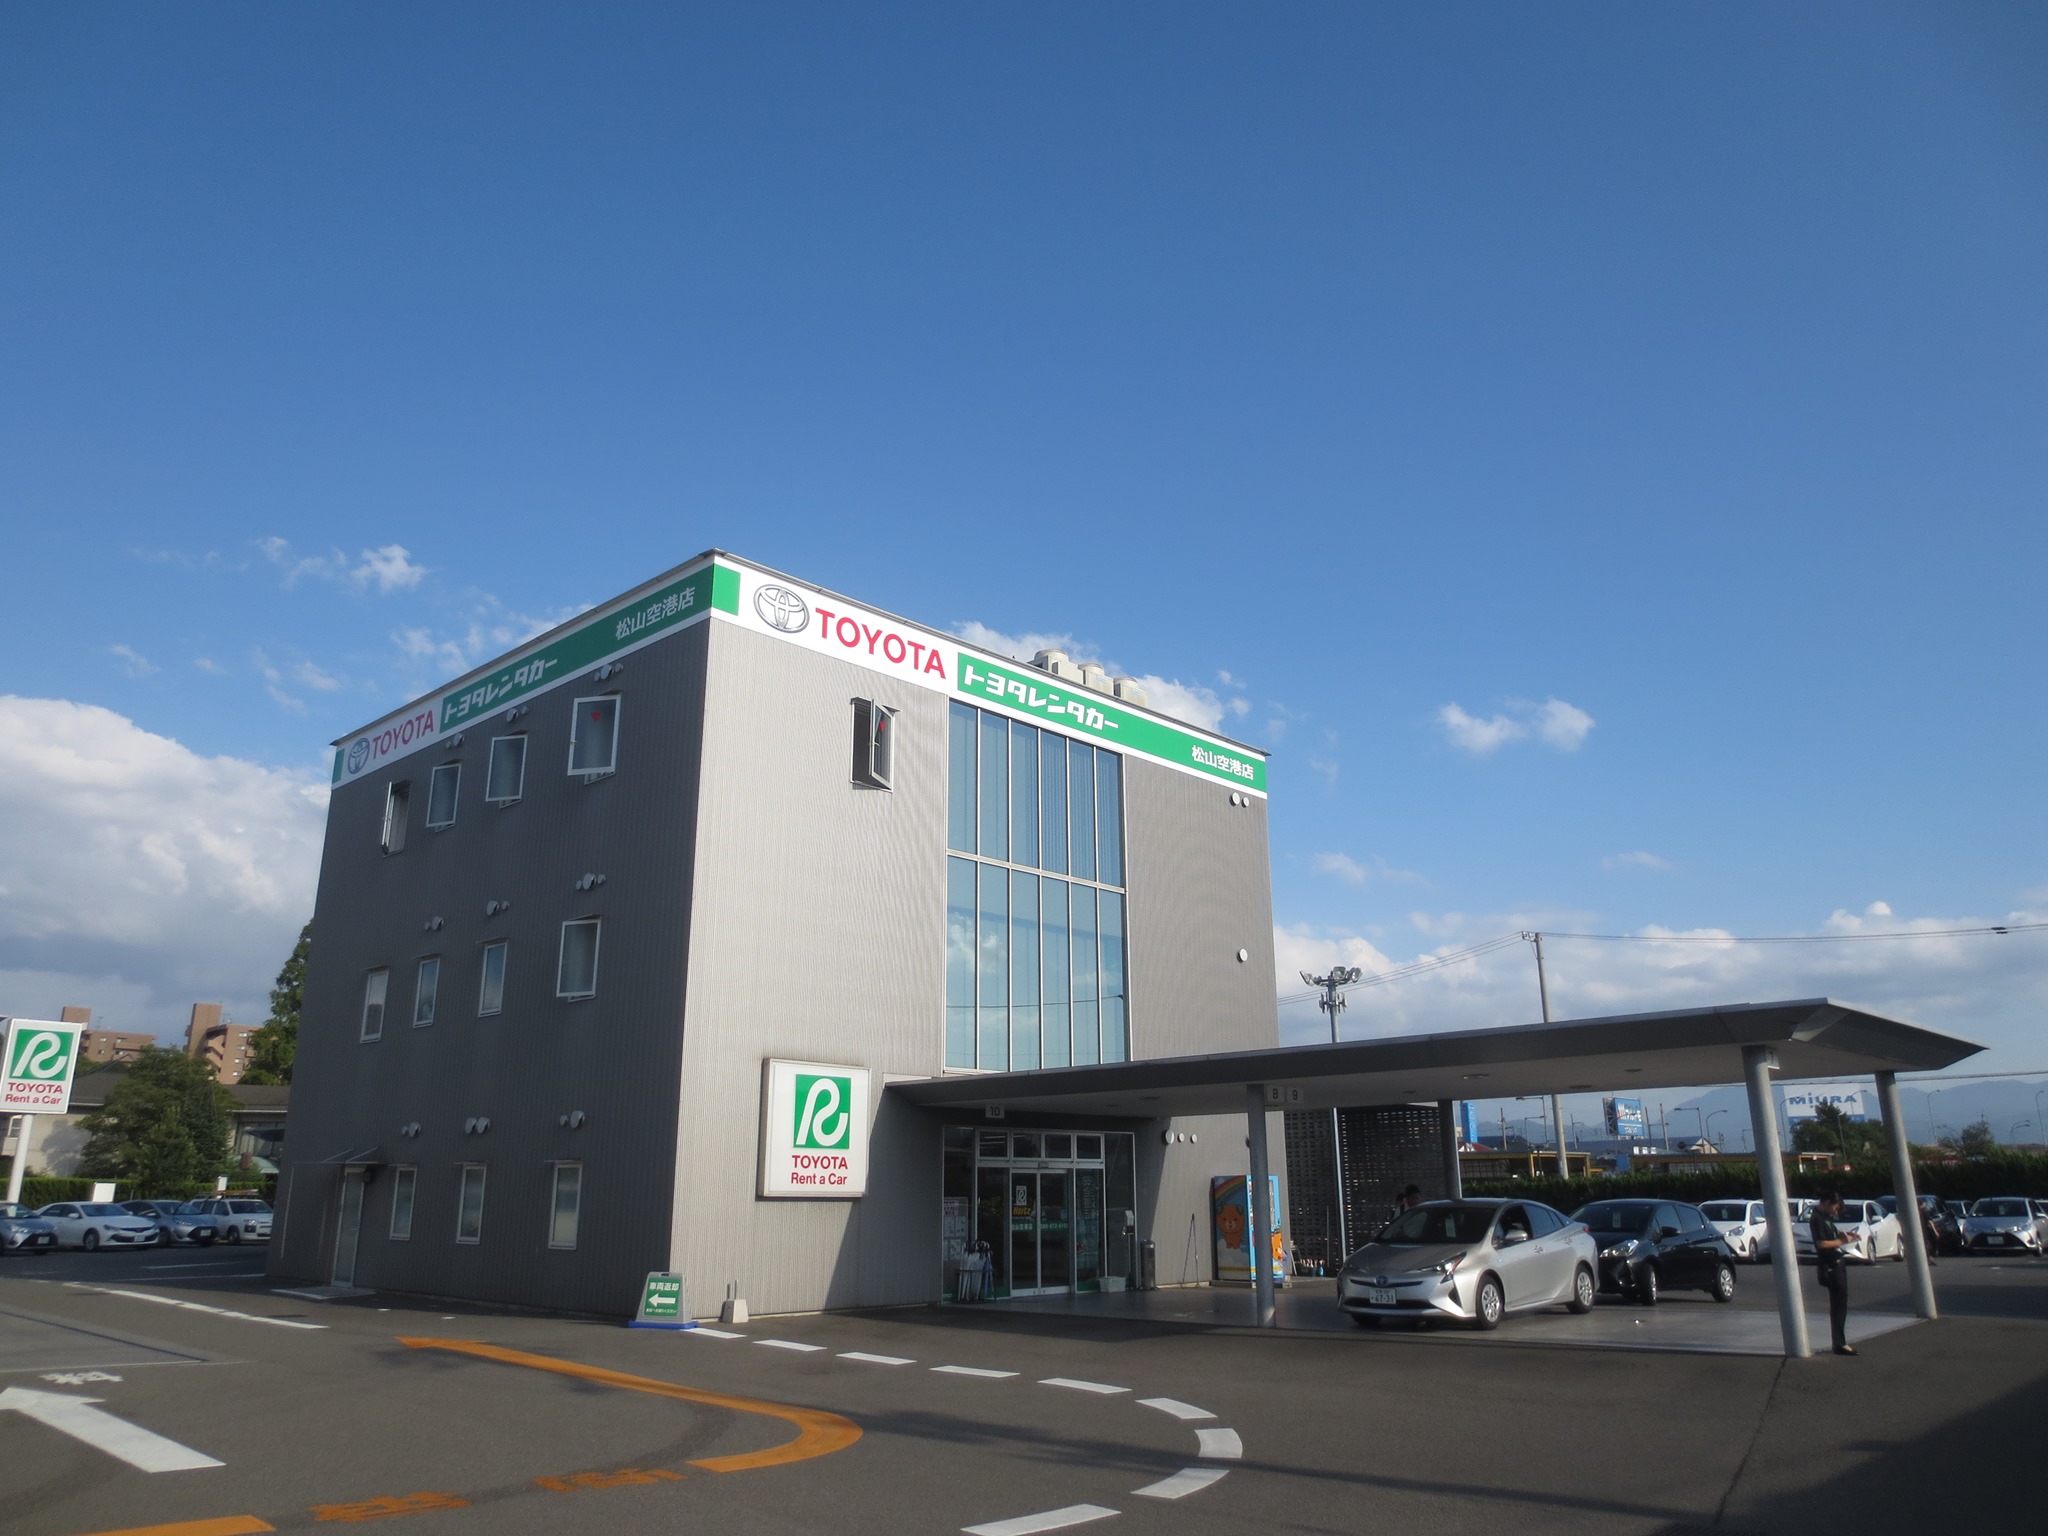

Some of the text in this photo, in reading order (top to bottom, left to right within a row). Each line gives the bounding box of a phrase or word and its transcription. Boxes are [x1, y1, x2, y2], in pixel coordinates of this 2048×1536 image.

[615, 586, 696, 641] 松山空港店
[815, 607, 946, 680] TOYOTA
[443, 657, 559, 724] トヨタレンタカー
[963, 664, 1119, 731] トヨタレンタカー
[371, 709, 434, 761] TOYOTA
[1191, 744, 1254, 781] 松山空港店
[8, 1082, 63, 1094] TOYOTA
[1272, 1088, 1279, 1099] 8
[5, 1093, 30, 1103] Rent
[42, 1095, 61, 1104] Car
[1292, 1089, 1298, 1101] 9
[990, 1106, 1001, 1116] 10
[792, 1155, 848, 1169] TOYOTA
[791, 1172, 847, 1185] Rent a Car
[649, 1282, 680, 1291] 車両返却
